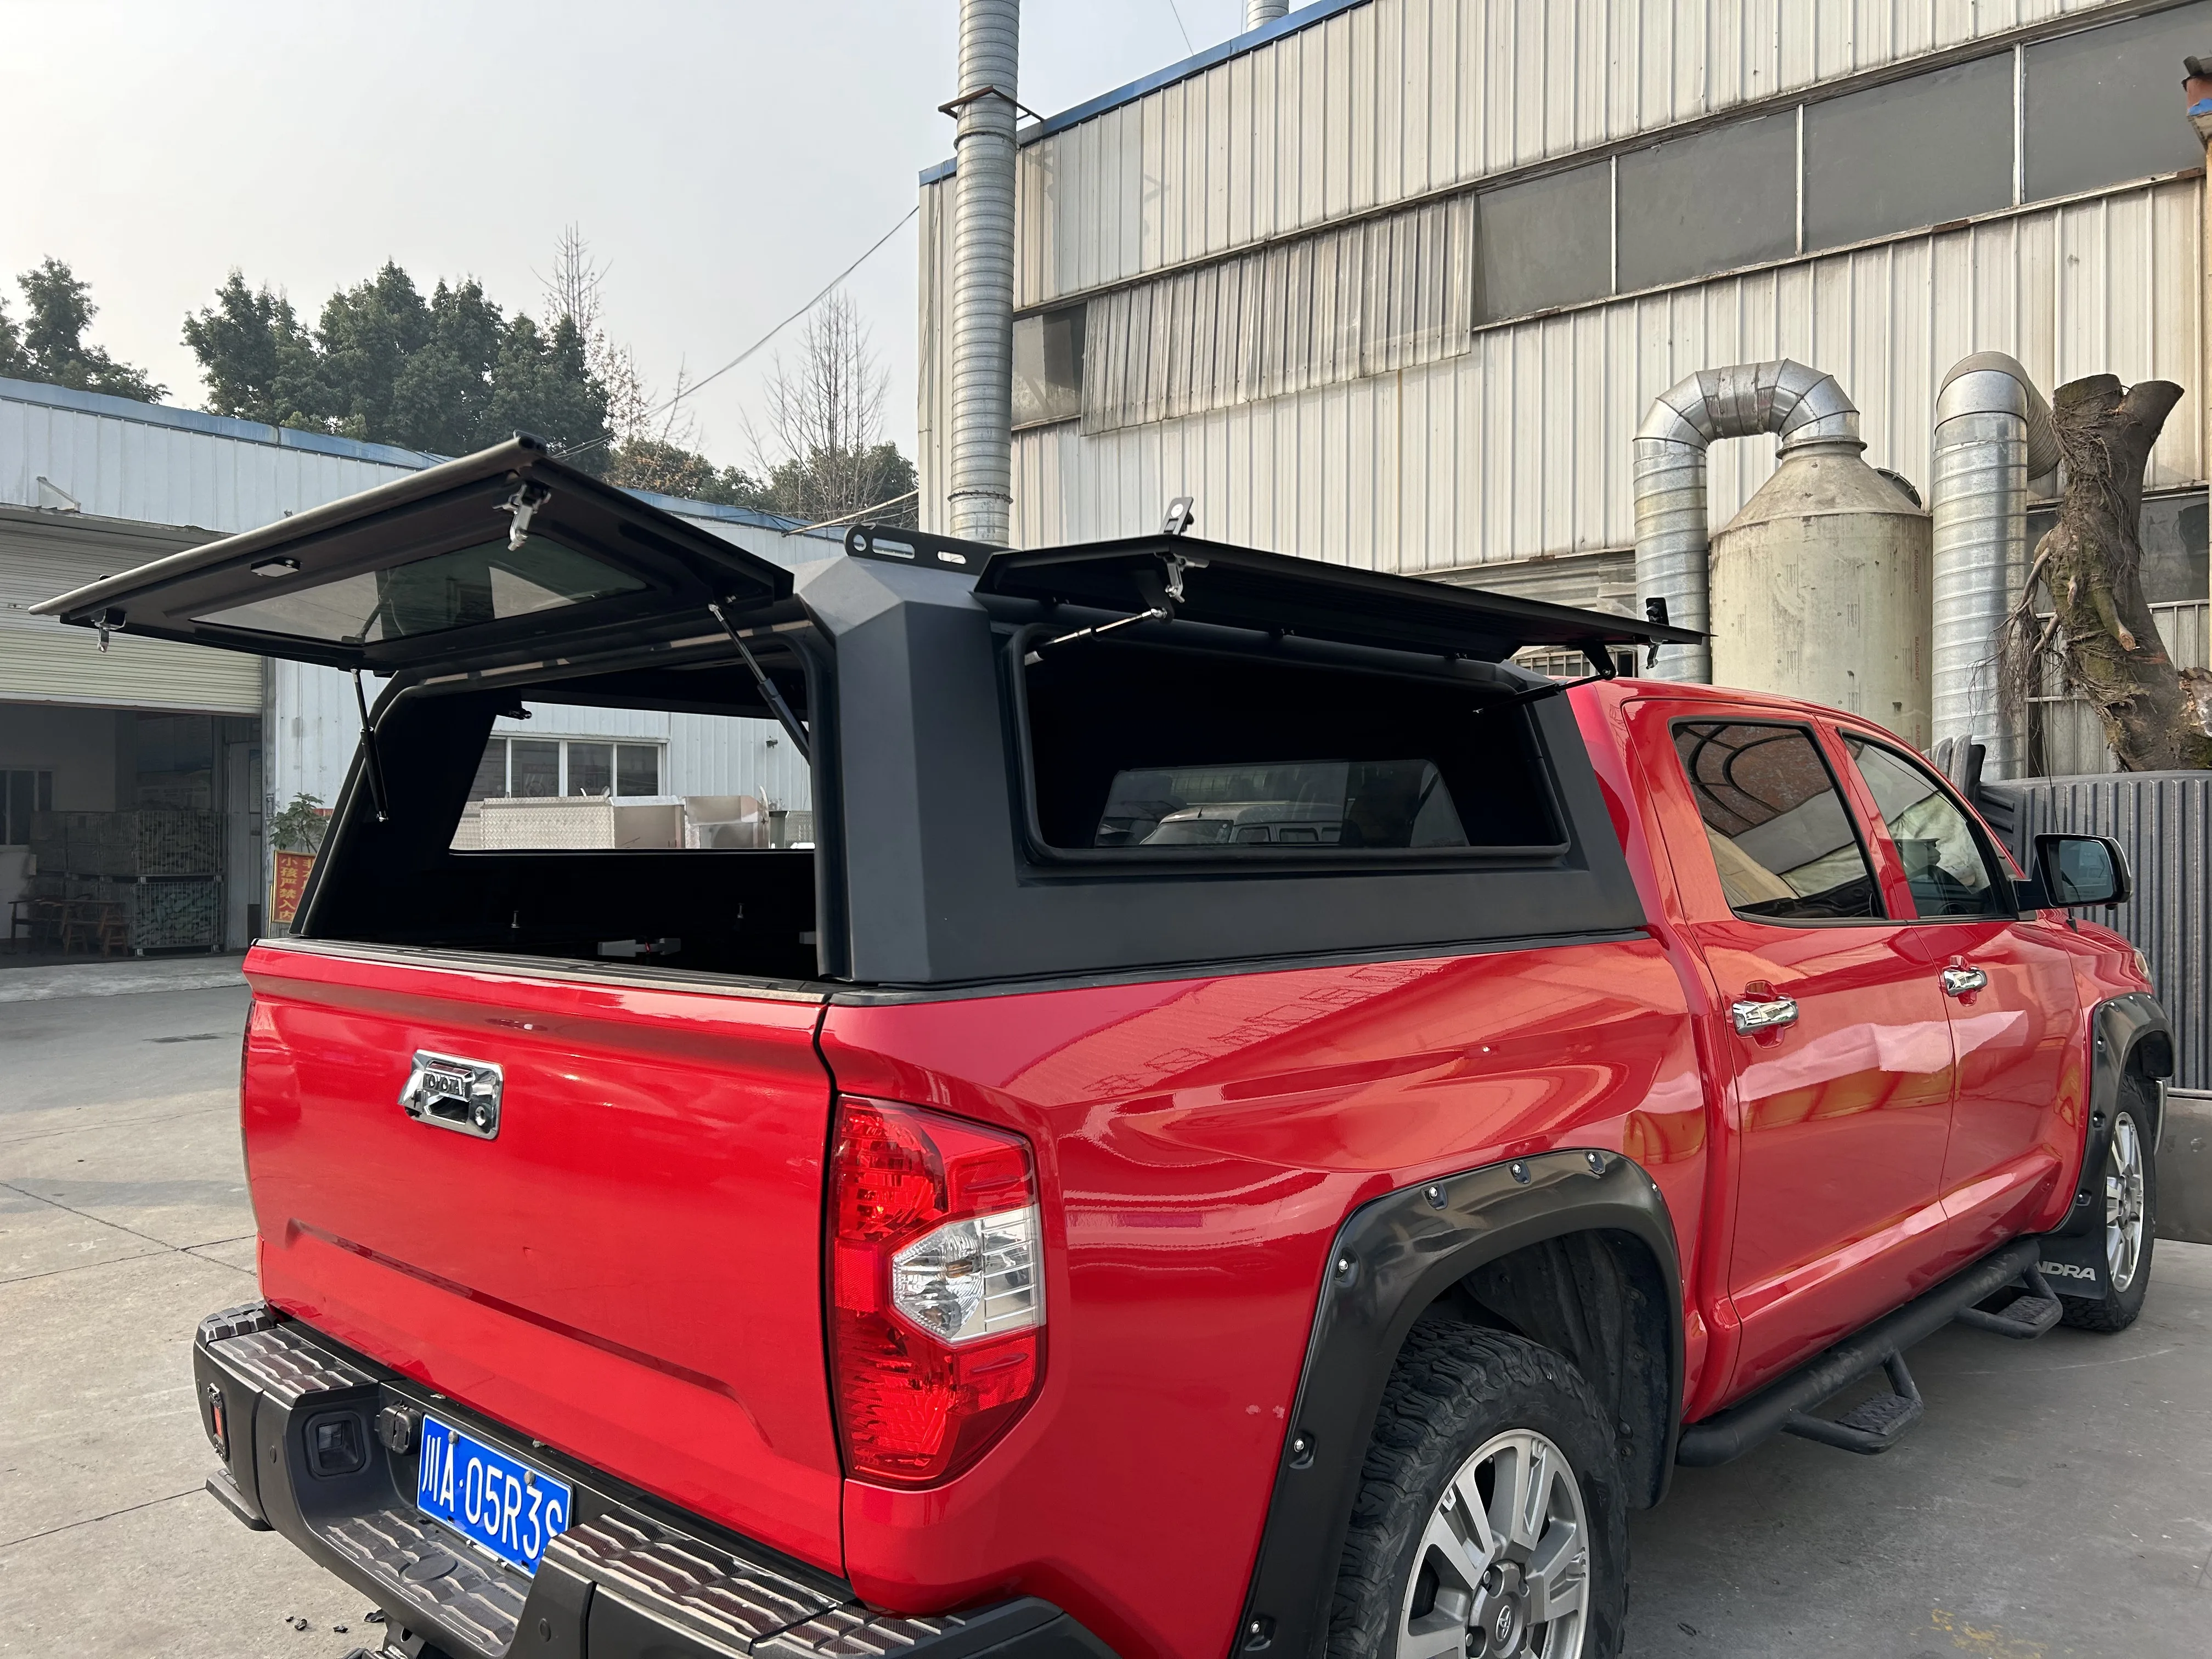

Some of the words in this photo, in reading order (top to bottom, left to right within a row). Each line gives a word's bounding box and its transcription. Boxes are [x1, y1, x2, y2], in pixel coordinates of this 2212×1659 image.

[279, 857, 298, 921] 小孩严禁入内
